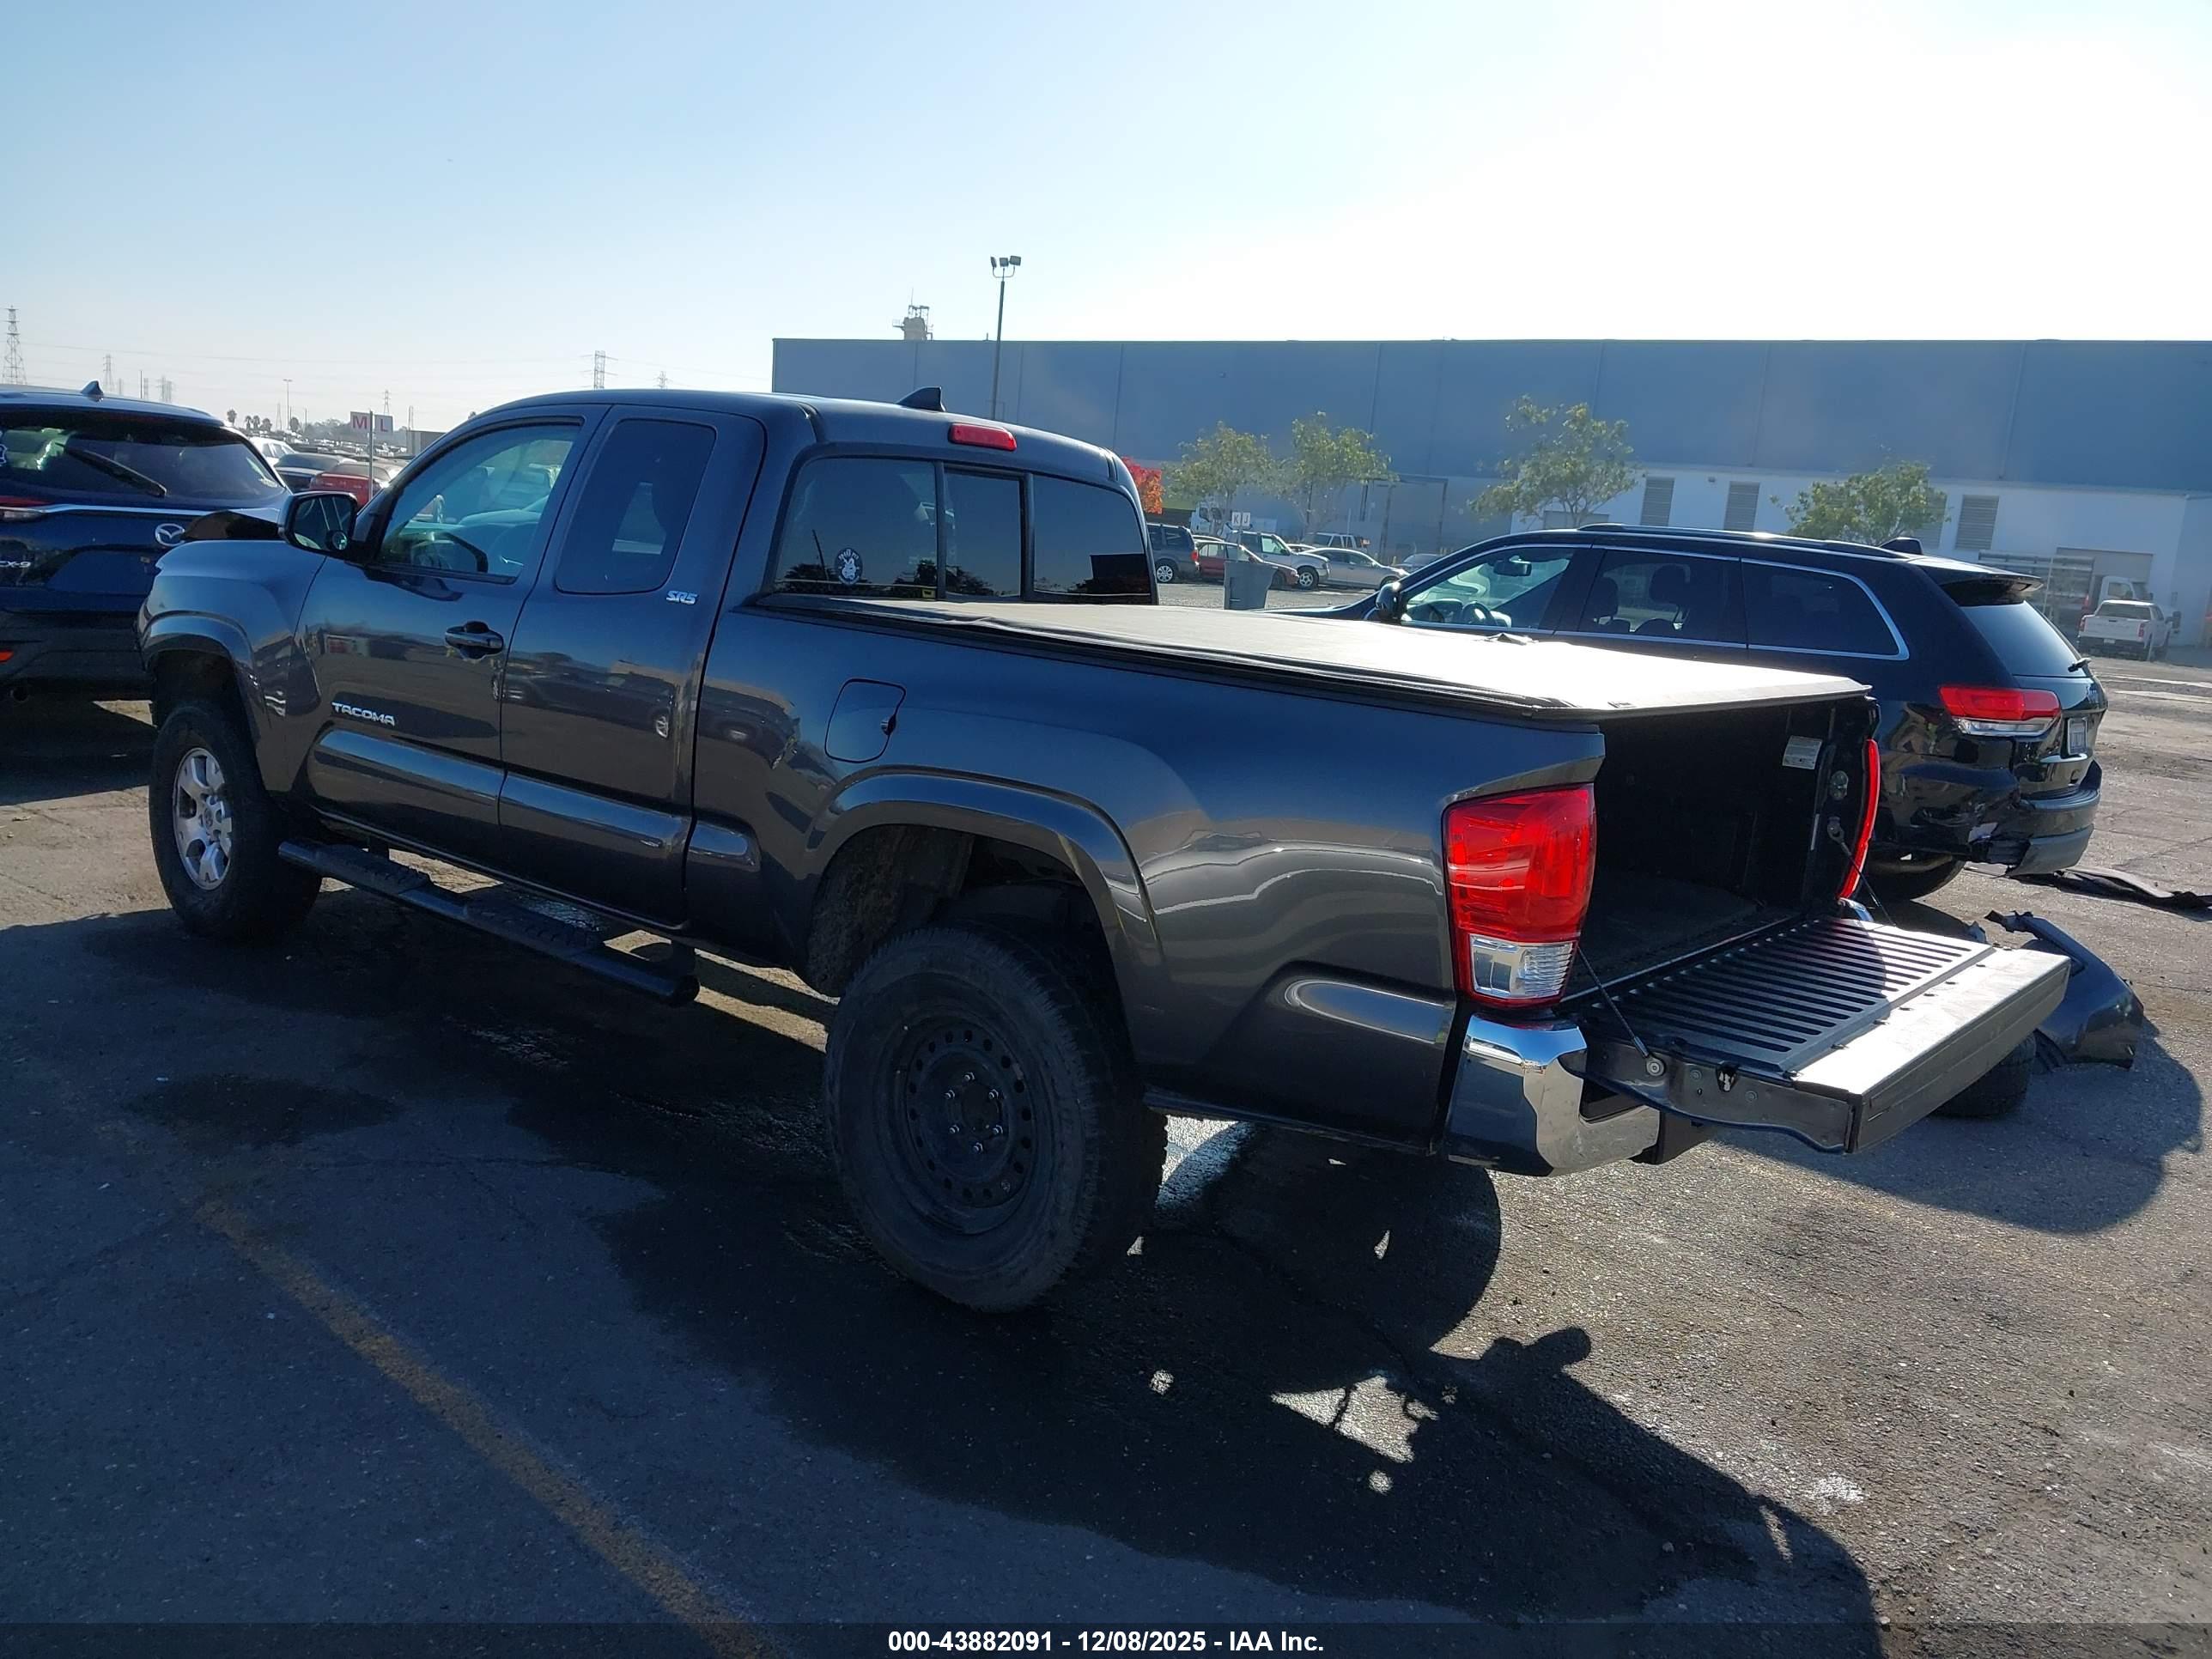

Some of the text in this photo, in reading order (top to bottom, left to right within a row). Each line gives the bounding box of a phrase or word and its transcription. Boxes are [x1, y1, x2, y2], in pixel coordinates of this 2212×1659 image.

[352, 415, 368, 429] M
[380, 418, 389, 433] L
[1233, 514, 1239, 524] K
[665, 590, 697, 605] SR5
[331, 702, 395, 726] TACOMA
